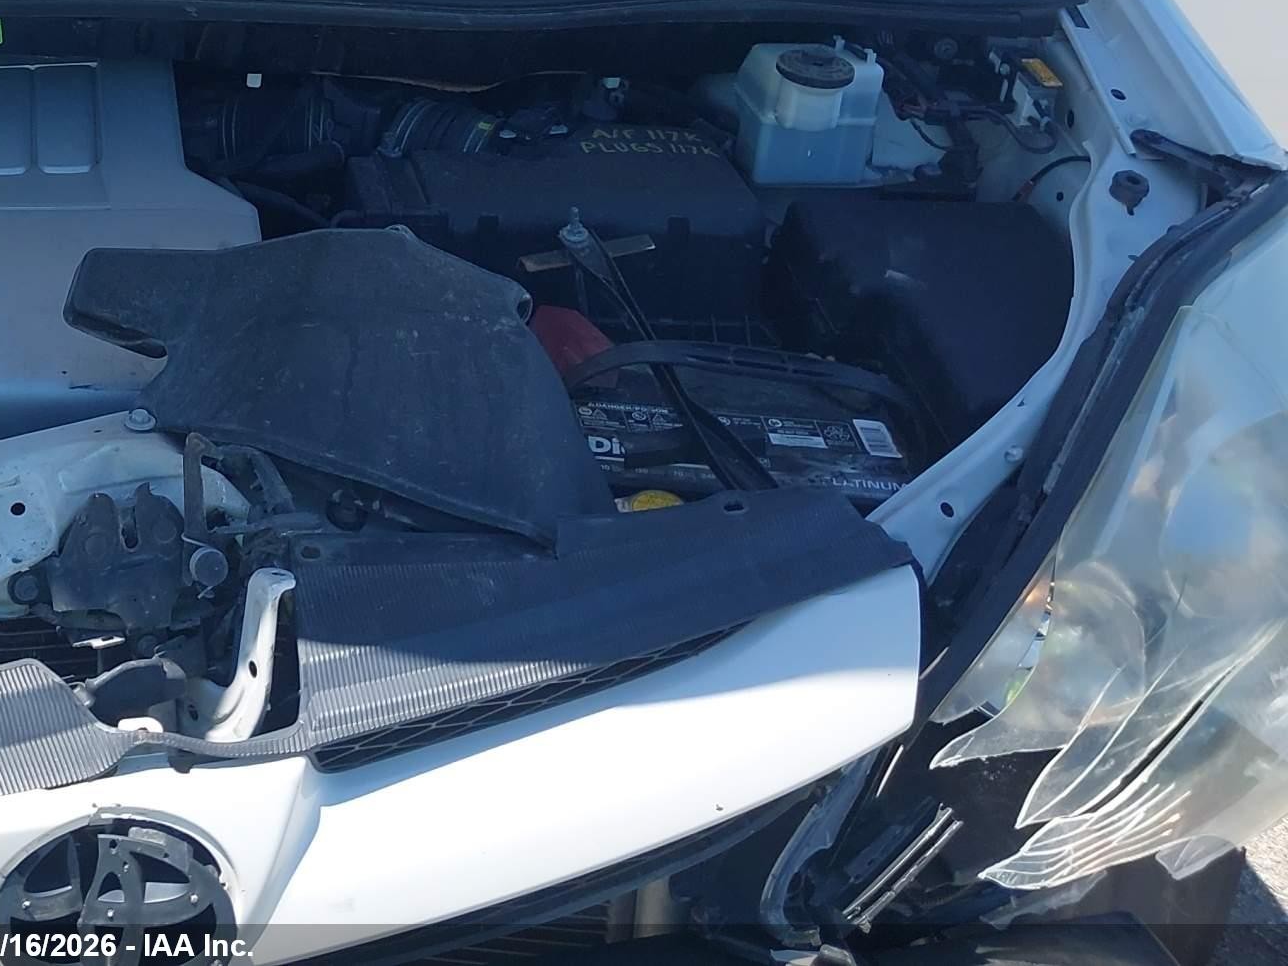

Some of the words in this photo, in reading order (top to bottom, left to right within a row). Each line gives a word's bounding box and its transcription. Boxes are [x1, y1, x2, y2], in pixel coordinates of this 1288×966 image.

[645, 128, 704, 143] 117K
[579, 141, 664, 155] PLUGS
[669, 142, 721, 159] 117K
